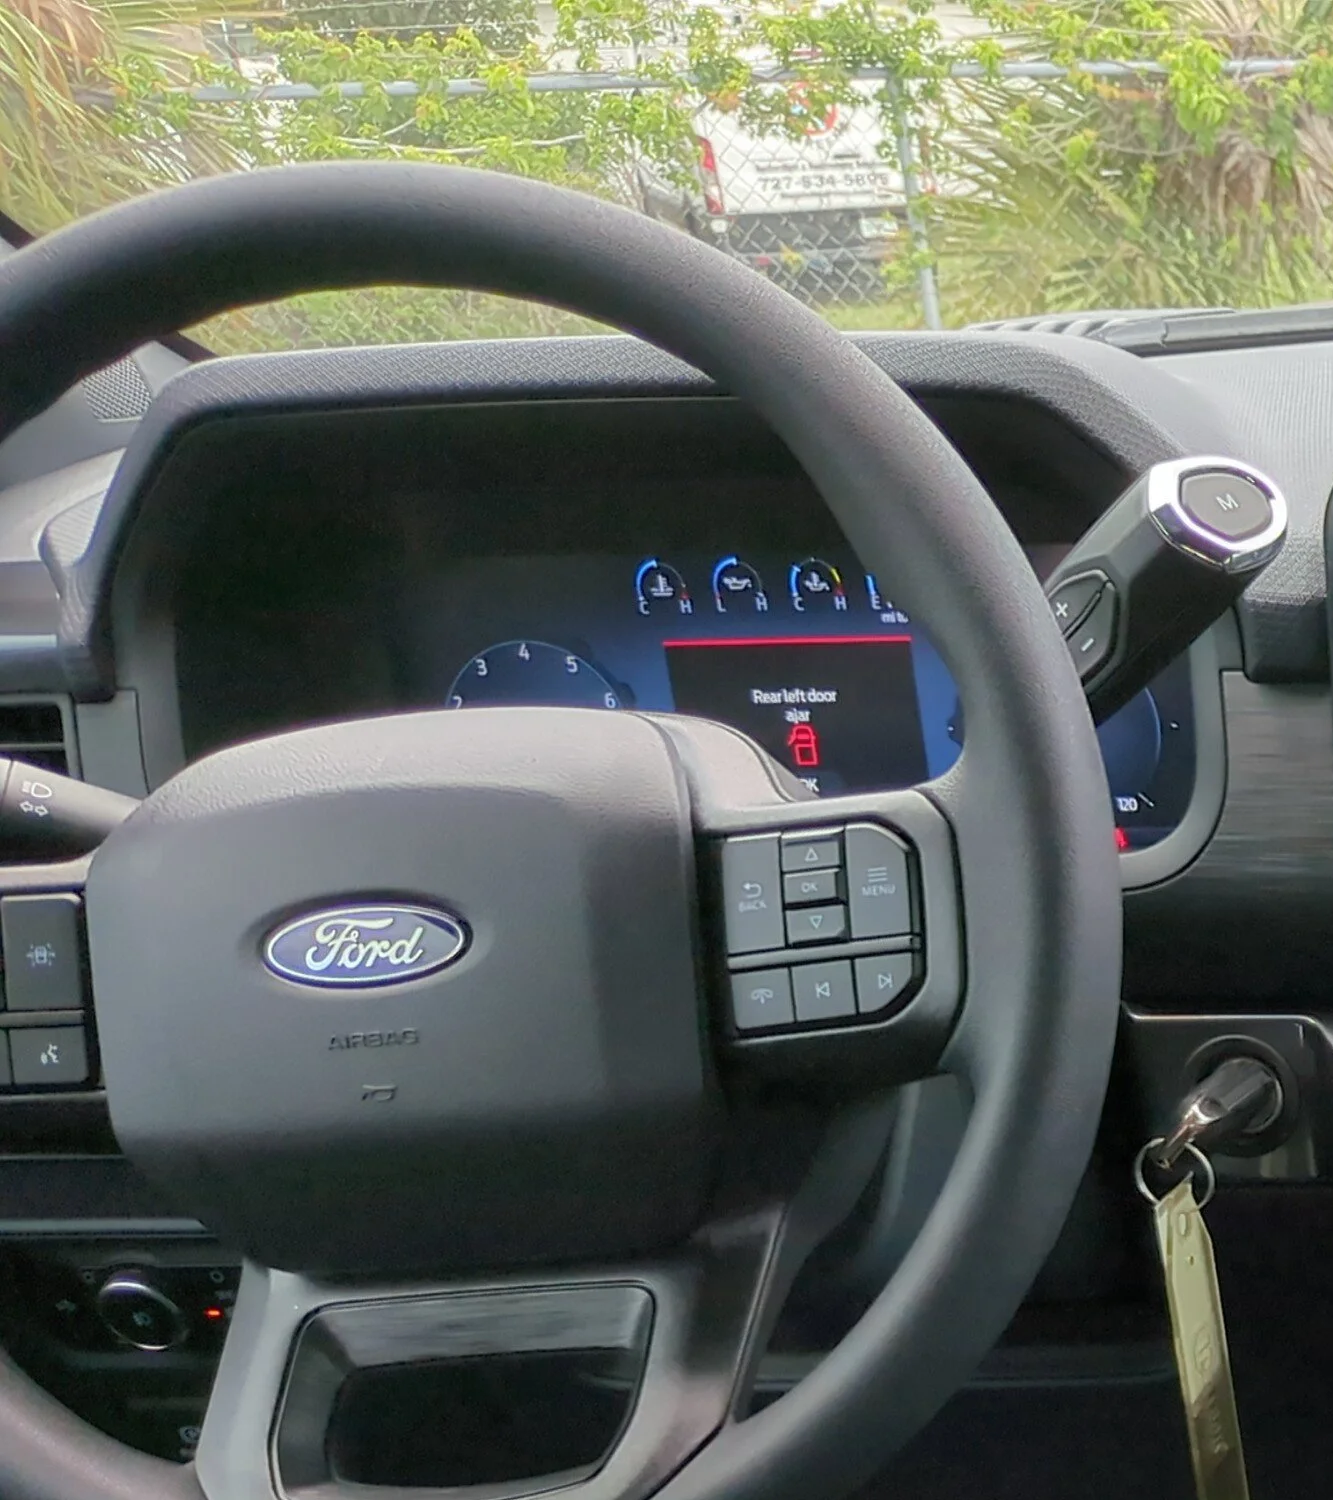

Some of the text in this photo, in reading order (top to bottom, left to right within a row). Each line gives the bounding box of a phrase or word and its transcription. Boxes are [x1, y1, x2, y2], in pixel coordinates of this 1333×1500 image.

[1216, 493, 1239, 512] M
[639, 600, 650, 615] C
[680, 600, 693, 614] H
[716, 599, 726, 613] L
[756, 598, 768, 611] H
[794, 598, 804, 611] C
[835, 597, 847, 610] H
[871, 595, 882, 610] E
[518, 643, 530, 660] 4
[476, 658, 488, 676] 3
[566, 656, 578, 673] 5
[604, 692, 616, 709] 6
[753, 687, 837, 704] Rear left door
[785, 709, 810, 724] ajar
[1116, 796, 1138, 811] 120
[801, 882, 818, 893] OK
[862, 884, 896, 896] MENU
[737, 900, 767, 913] BACK
[305, 917, 423, 971] Ford
[328, 1027, 420, 1051] AIRBAG
